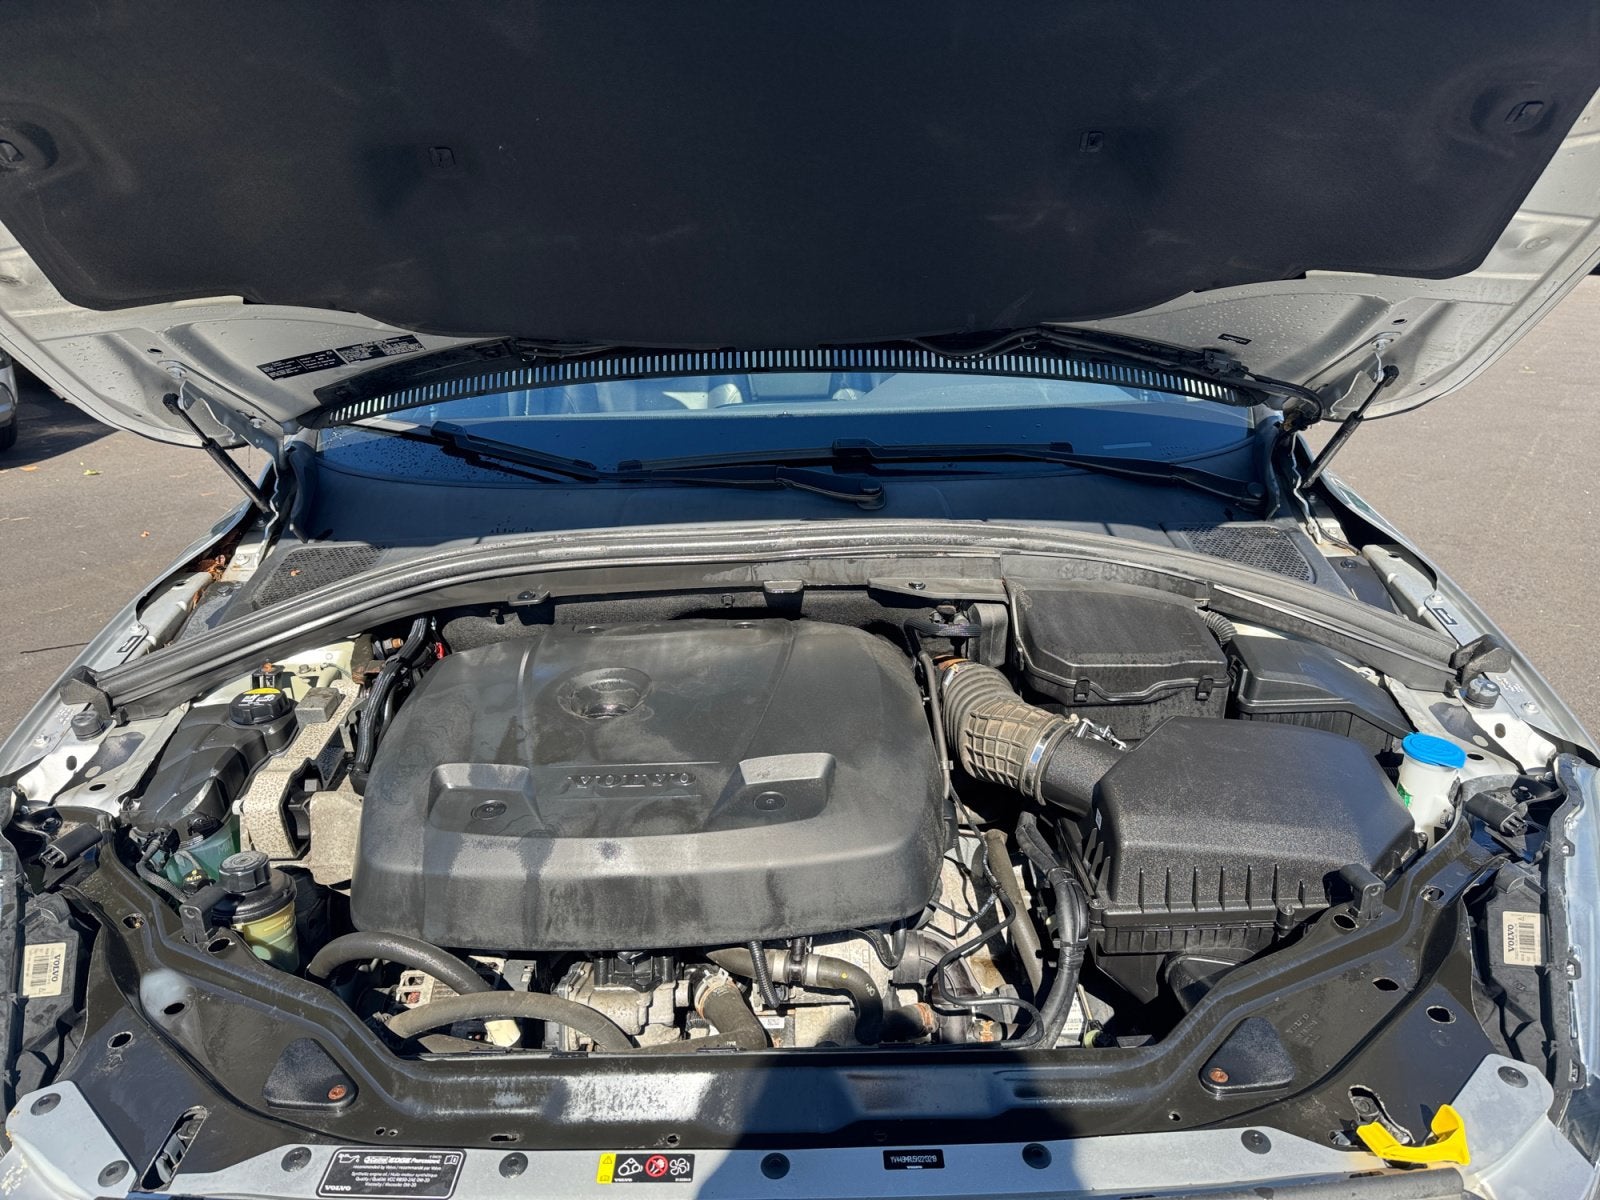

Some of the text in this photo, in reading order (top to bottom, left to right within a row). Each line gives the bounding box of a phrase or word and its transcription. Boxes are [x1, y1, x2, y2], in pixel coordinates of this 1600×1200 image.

[567, 772, 697, 789] VOLVO
[1507, 923, 1515, 953] VOLVO
[51, 953, 62, 982] VOLVO
